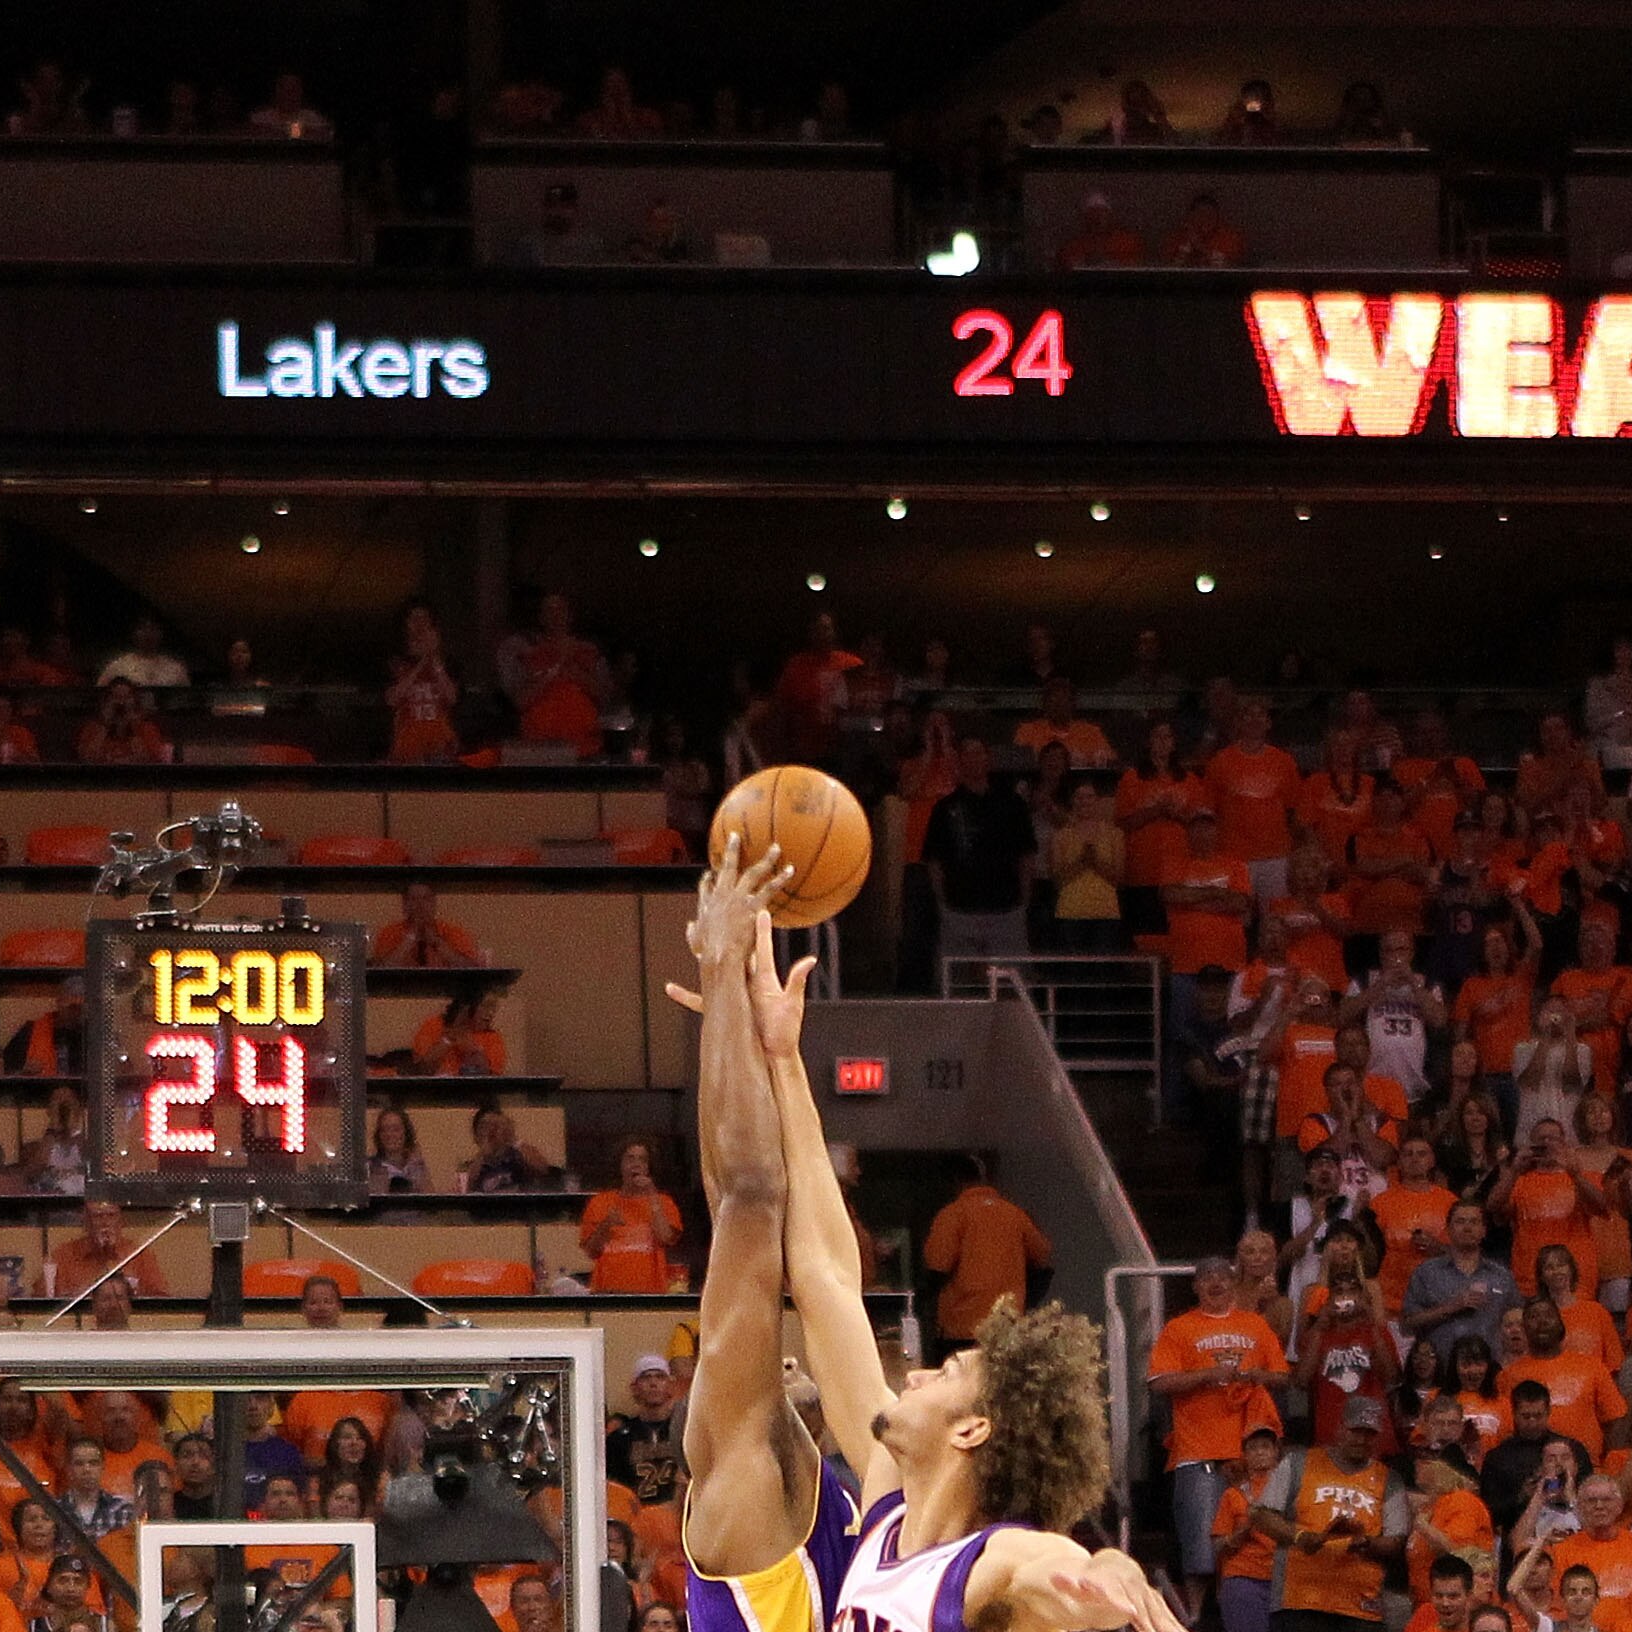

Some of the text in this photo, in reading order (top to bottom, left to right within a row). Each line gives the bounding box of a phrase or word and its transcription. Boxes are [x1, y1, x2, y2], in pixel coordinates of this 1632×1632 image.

[216, 321, 489, 399] Lakers
[951, 307, 1074, 396] 24
[149, 949, 325, 1026] 12:00
[1385, 1018, 1411, 1037] 33
[144, 1034, 306, 1154] 24
[1314, 1485, 1377, 1517] PHX
